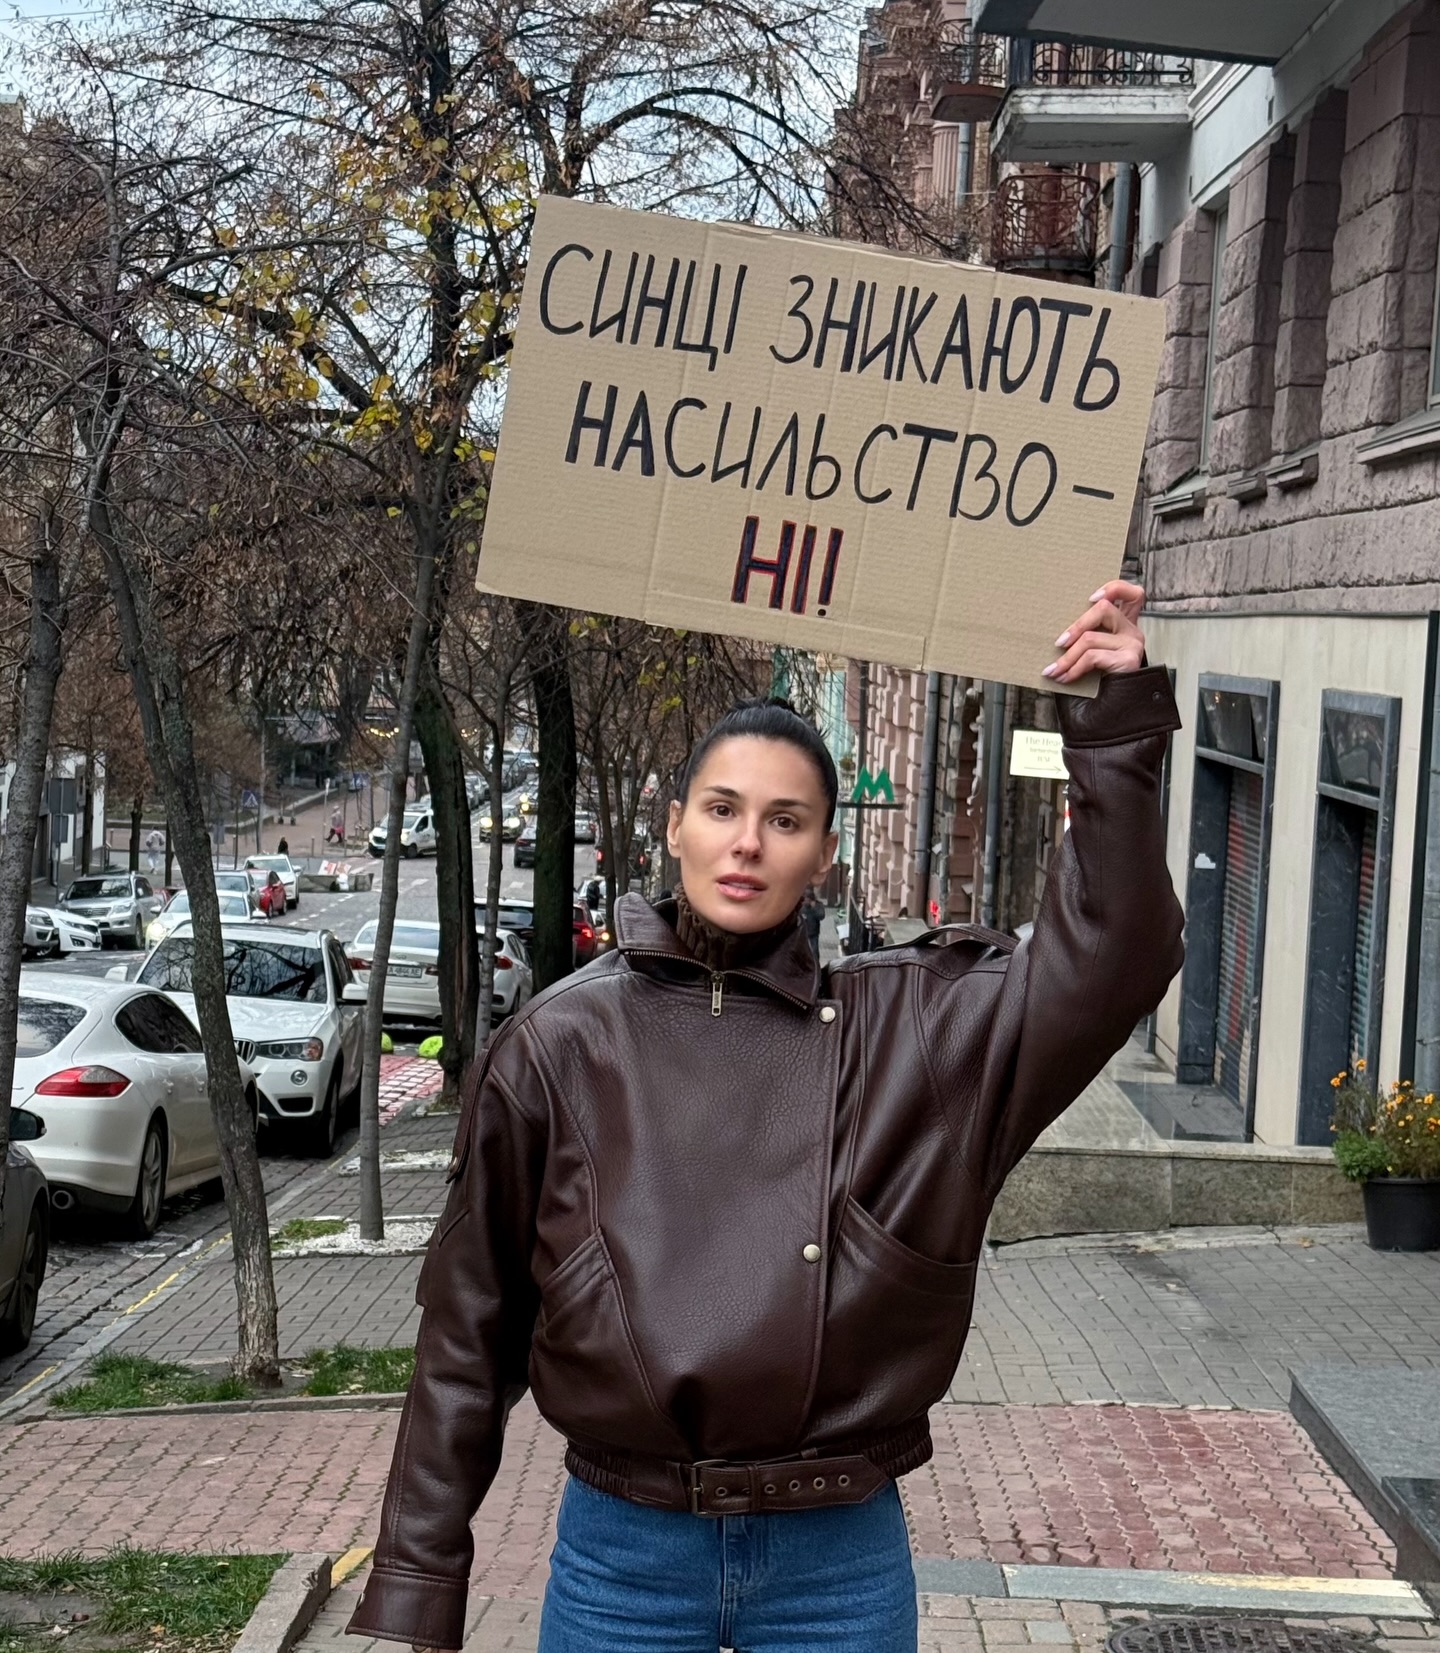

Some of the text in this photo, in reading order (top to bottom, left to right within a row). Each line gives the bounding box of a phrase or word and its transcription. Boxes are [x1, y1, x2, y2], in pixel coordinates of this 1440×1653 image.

[539, 243, 1121, 412] СИНЦІ ЗНИКАЮТЬ
[564, 380, 1058, 527] НАСИЛЬСТВО
[731, 515, 844, 616] НІ!
